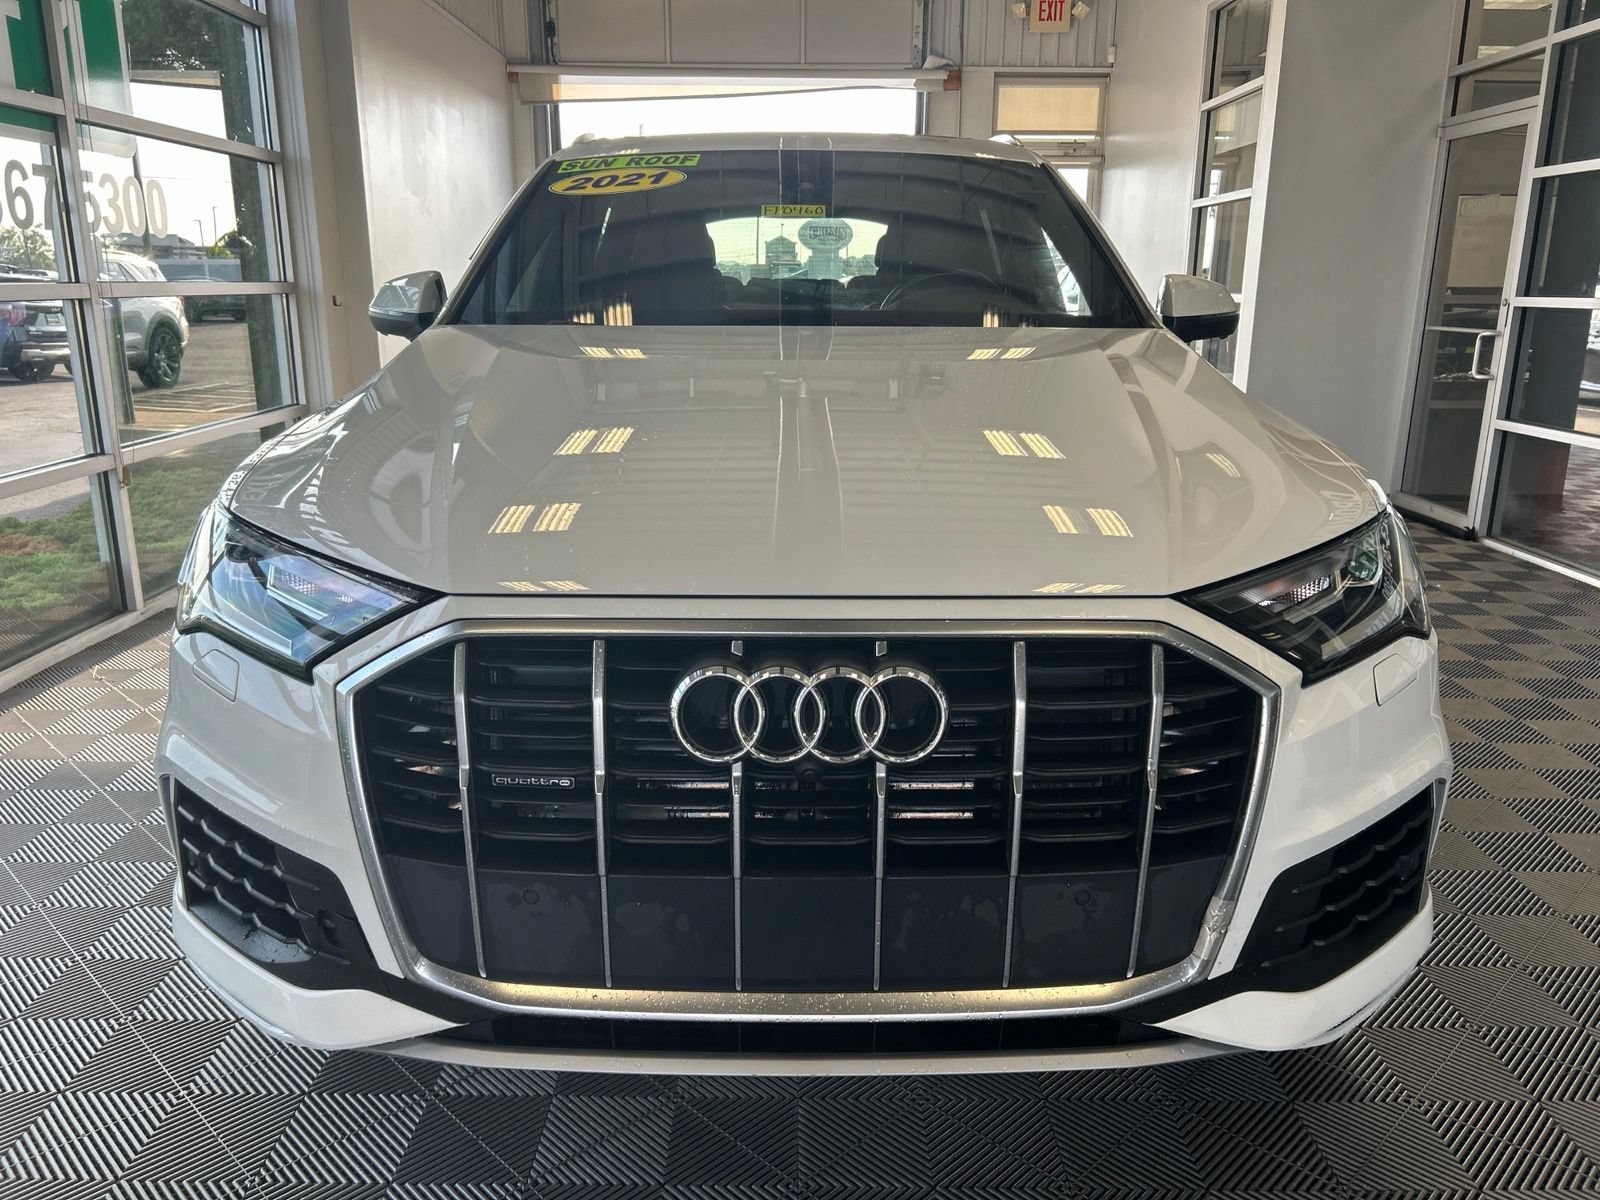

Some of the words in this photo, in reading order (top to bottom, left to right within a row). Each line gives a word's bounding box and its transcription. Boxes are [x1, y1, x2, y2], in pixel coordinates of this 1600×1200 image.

[1038, 0, 1065, 22] EXIT
[561, 157, 617, 172] SUN
[628, 154, 697, 168] ROOF
[562, 171, 670, 192] 2021
[0, 159, 55, 231] 67
[495, 776, 571, 787] quattro
